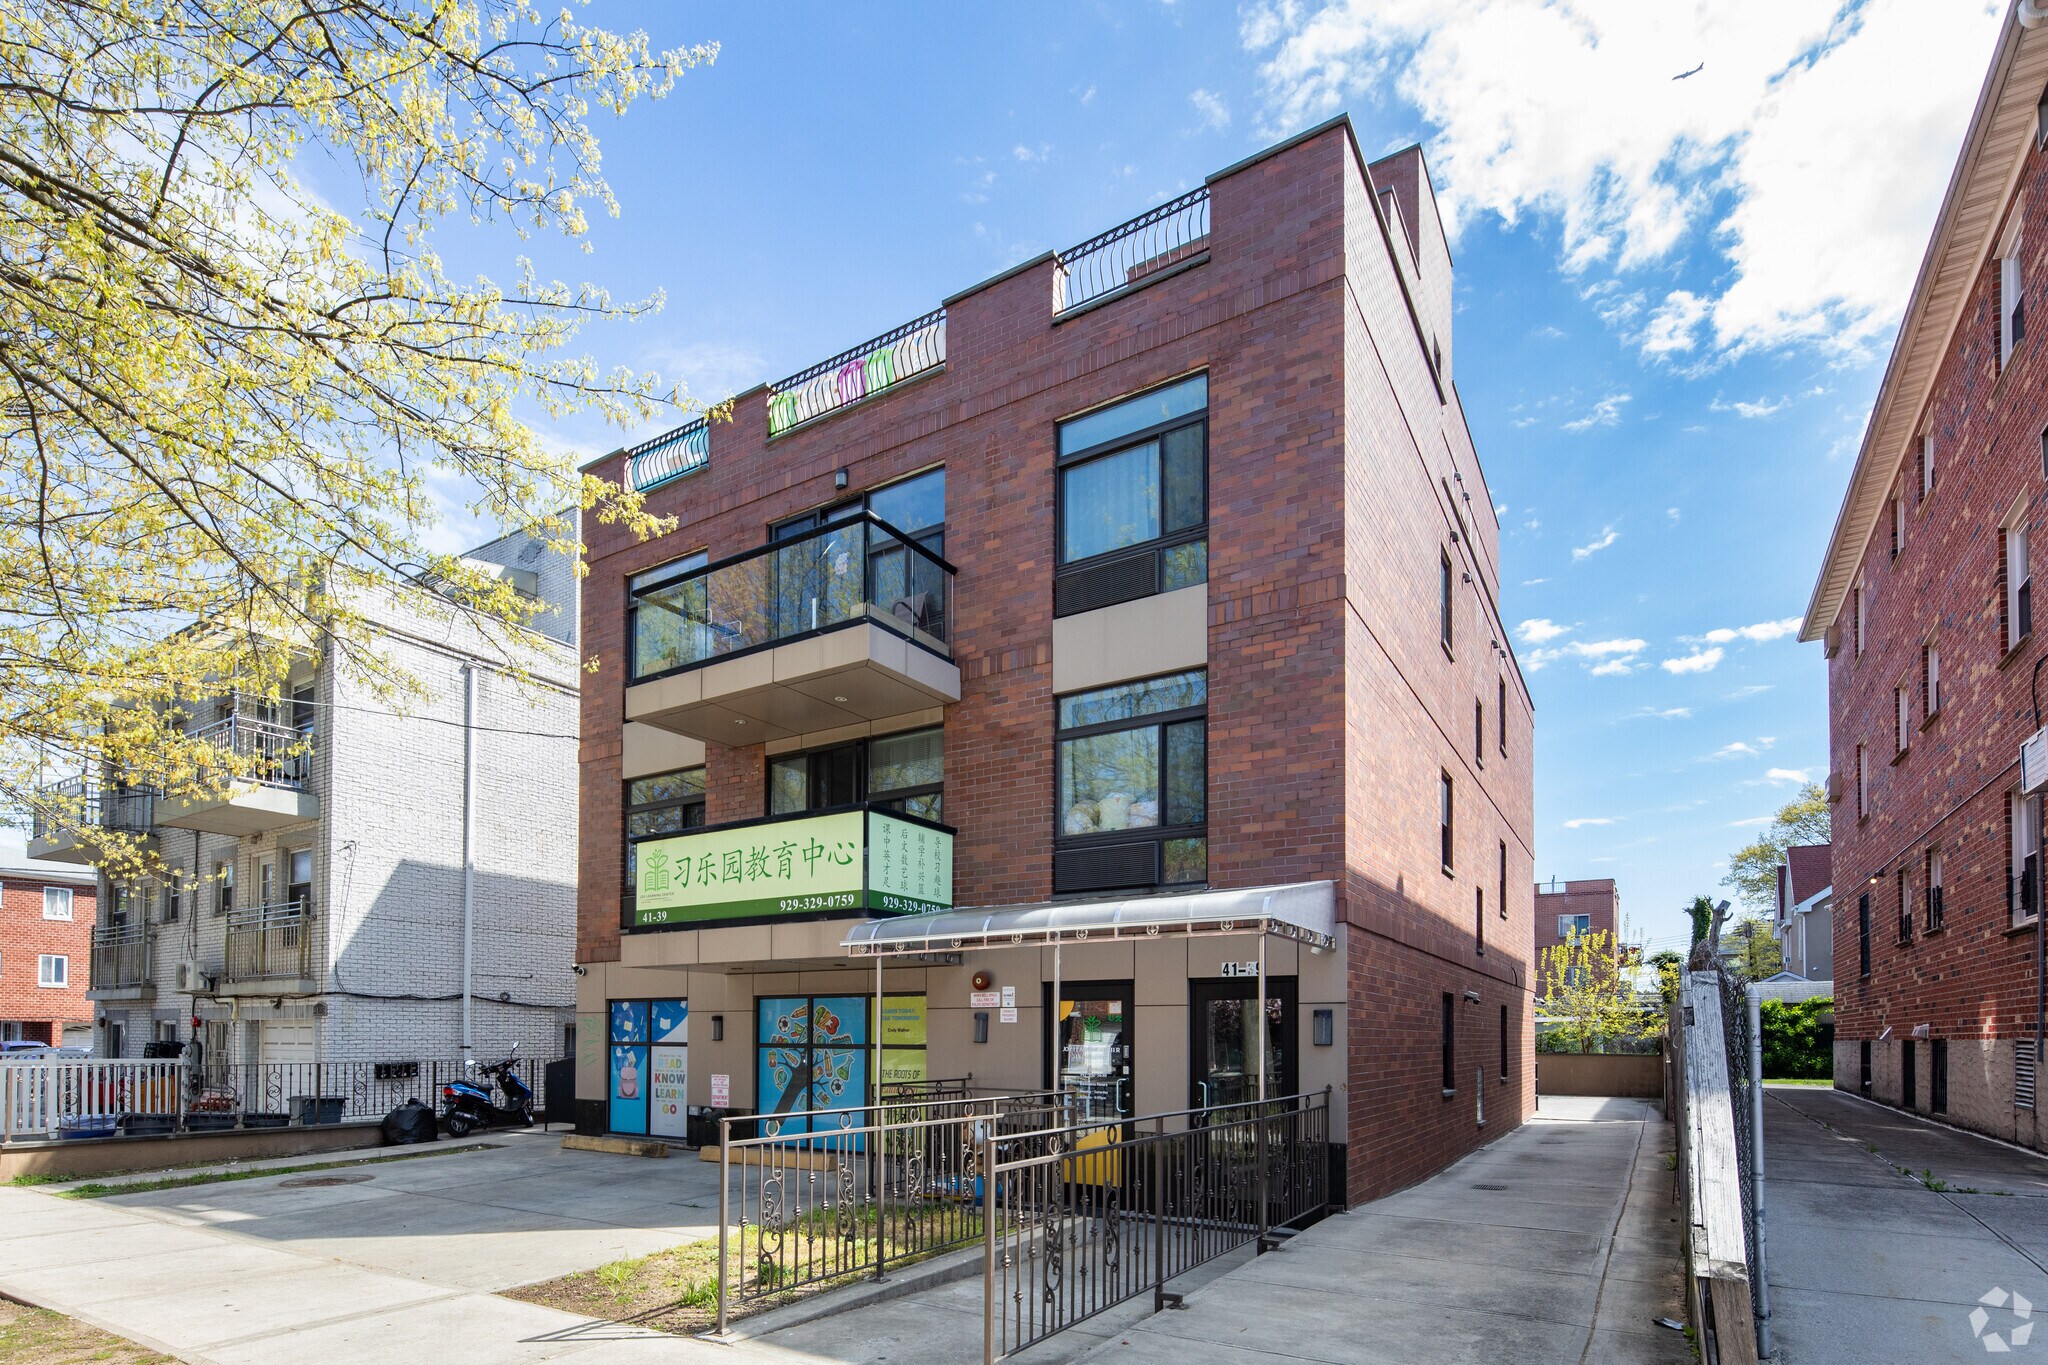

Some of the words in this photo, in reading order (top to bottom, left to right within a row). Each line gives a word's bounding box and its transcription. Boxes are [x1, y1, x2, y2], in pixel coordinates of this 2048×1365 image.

[673, 836, 856, 889] 习乐园教育中心
[780, 894, 855, 911] 929-329-0759
[642, 911, 667, 923] 41-39
[658, 1058, 682, 1069] READ
[654, 1072, 686, 1084] KNOW
[882, 1069, 892, 1079] THE
[893, 1069, 911, 1079] ROOTS
[912, 1070, 921, 1079] OF
[655, 1087, 685, 1099] LEARN
[662, 1103, 677, 1115] GO
